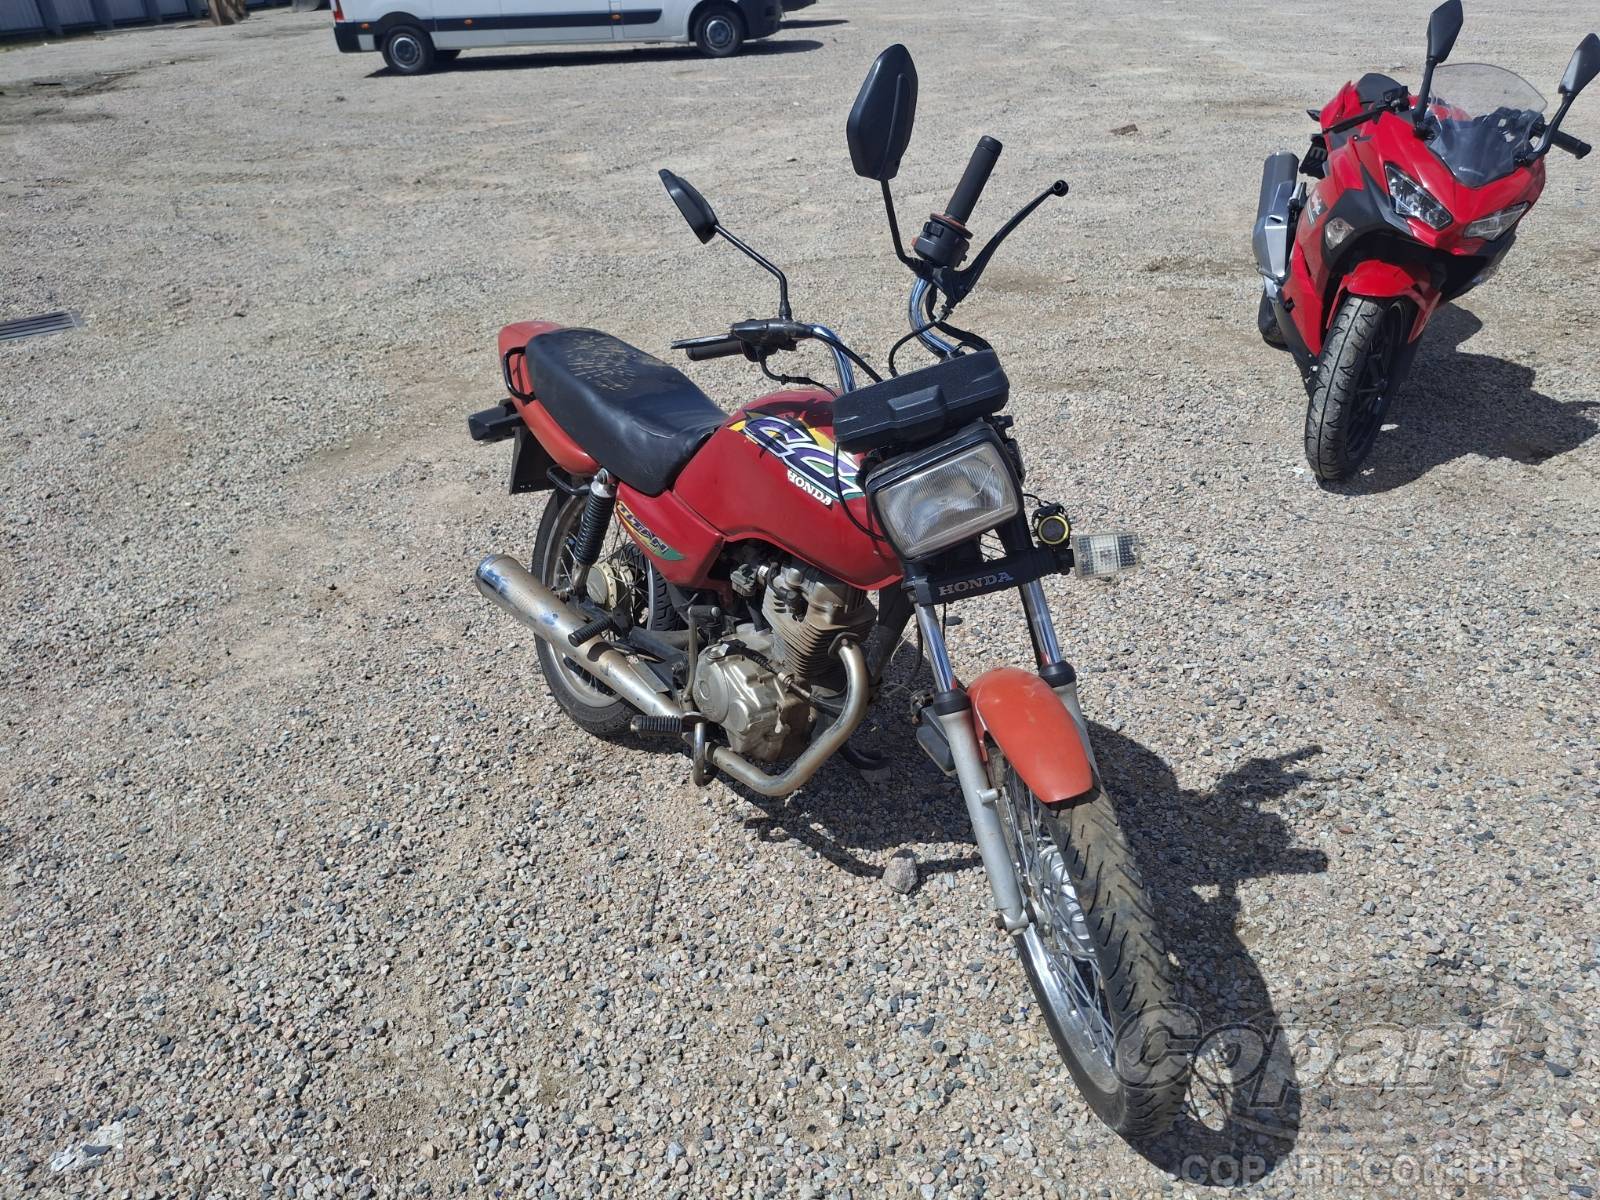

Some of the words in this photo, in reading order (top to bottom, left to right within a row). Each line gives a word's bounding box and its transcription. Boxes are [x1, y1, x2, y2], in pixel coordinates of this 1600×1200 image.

[787, 469, 833, 506] HONDA
[616, 501, 669, 553] TITAN
[938, 572, 1014, 596] HONDA
